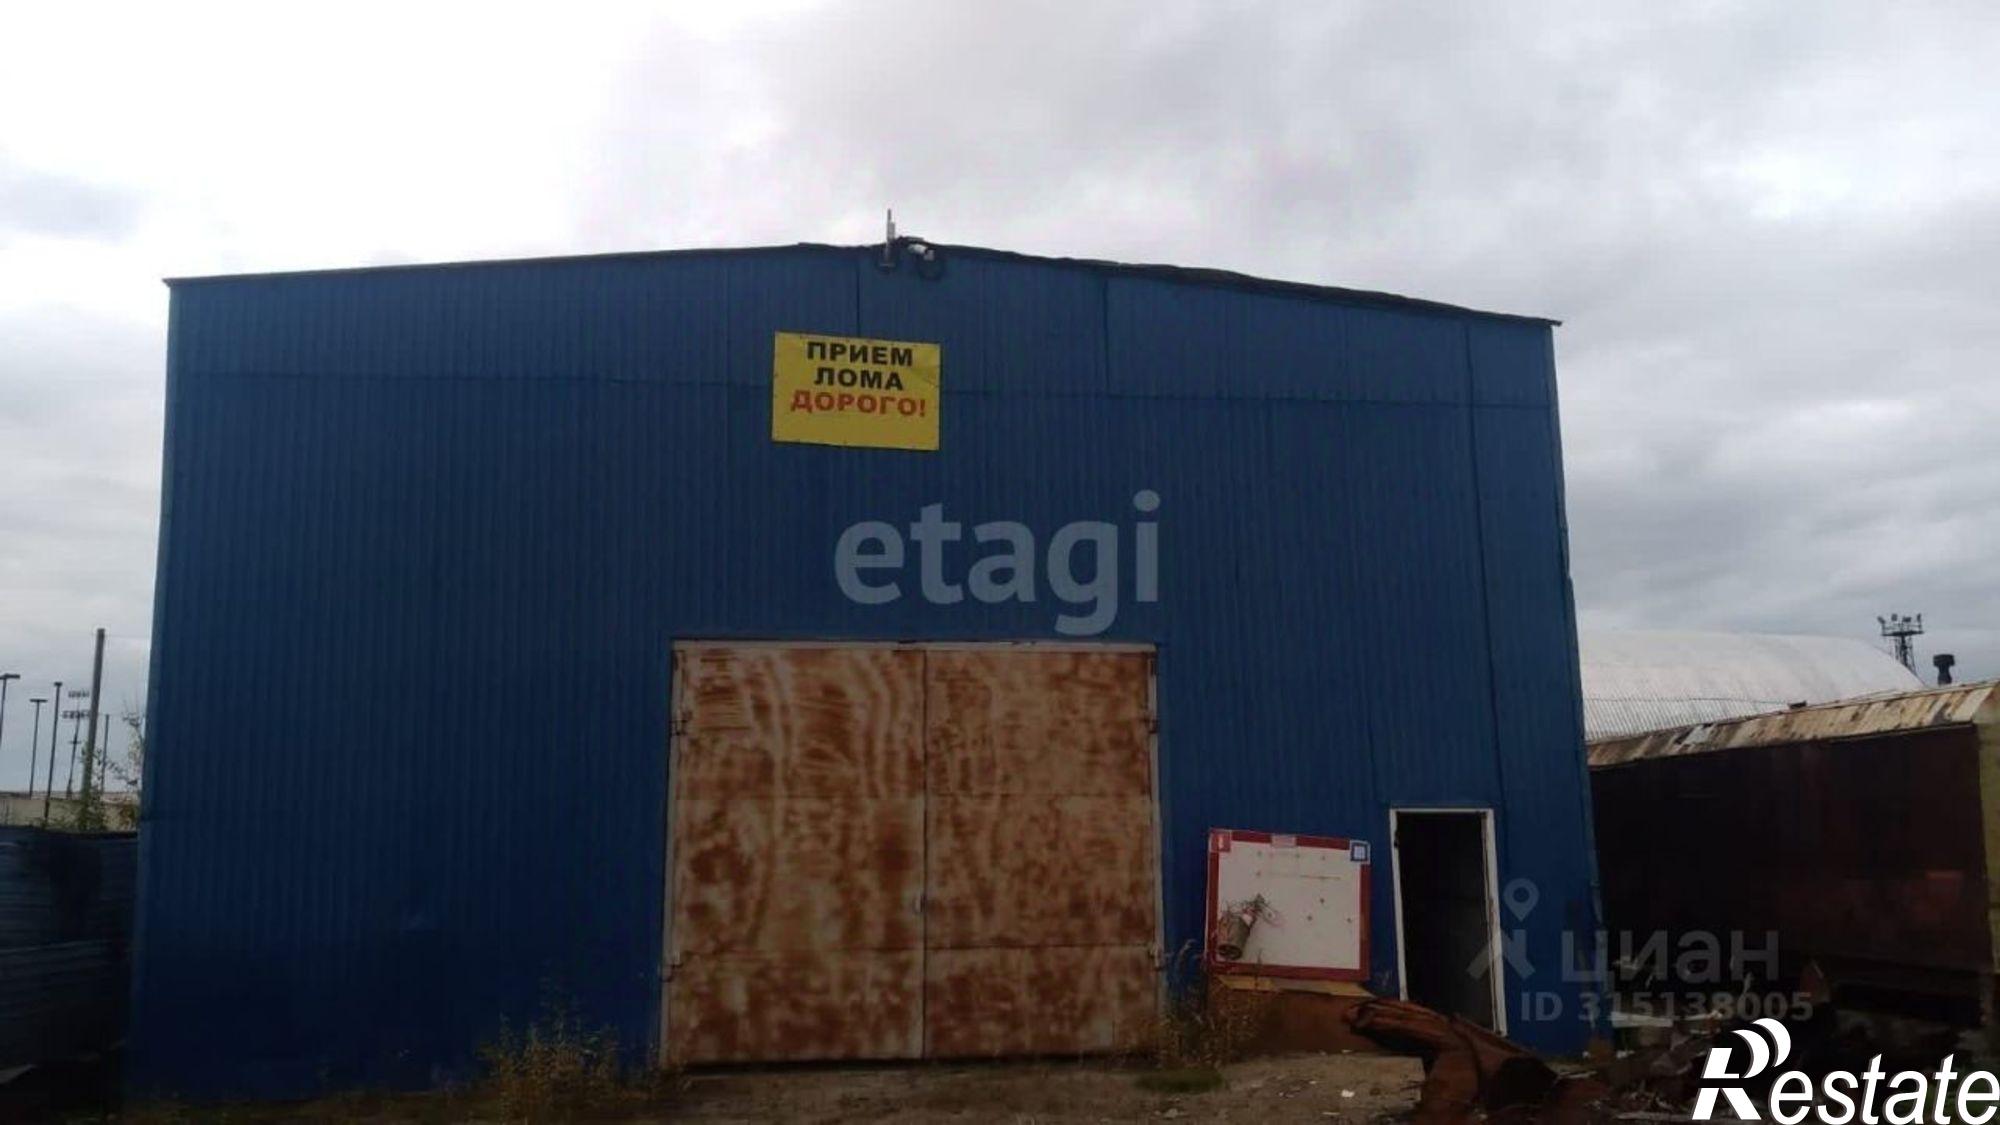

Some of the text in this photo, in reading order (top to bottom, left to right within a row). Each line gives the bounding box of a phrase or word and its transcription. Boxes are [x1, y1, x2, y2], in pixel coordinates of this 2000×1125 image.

[807, 341, 913, 367] ПРИЕМ
[813, 367, 904, 391] ЛОМА
[790, 389, 926, 417] ДОРОГО!
